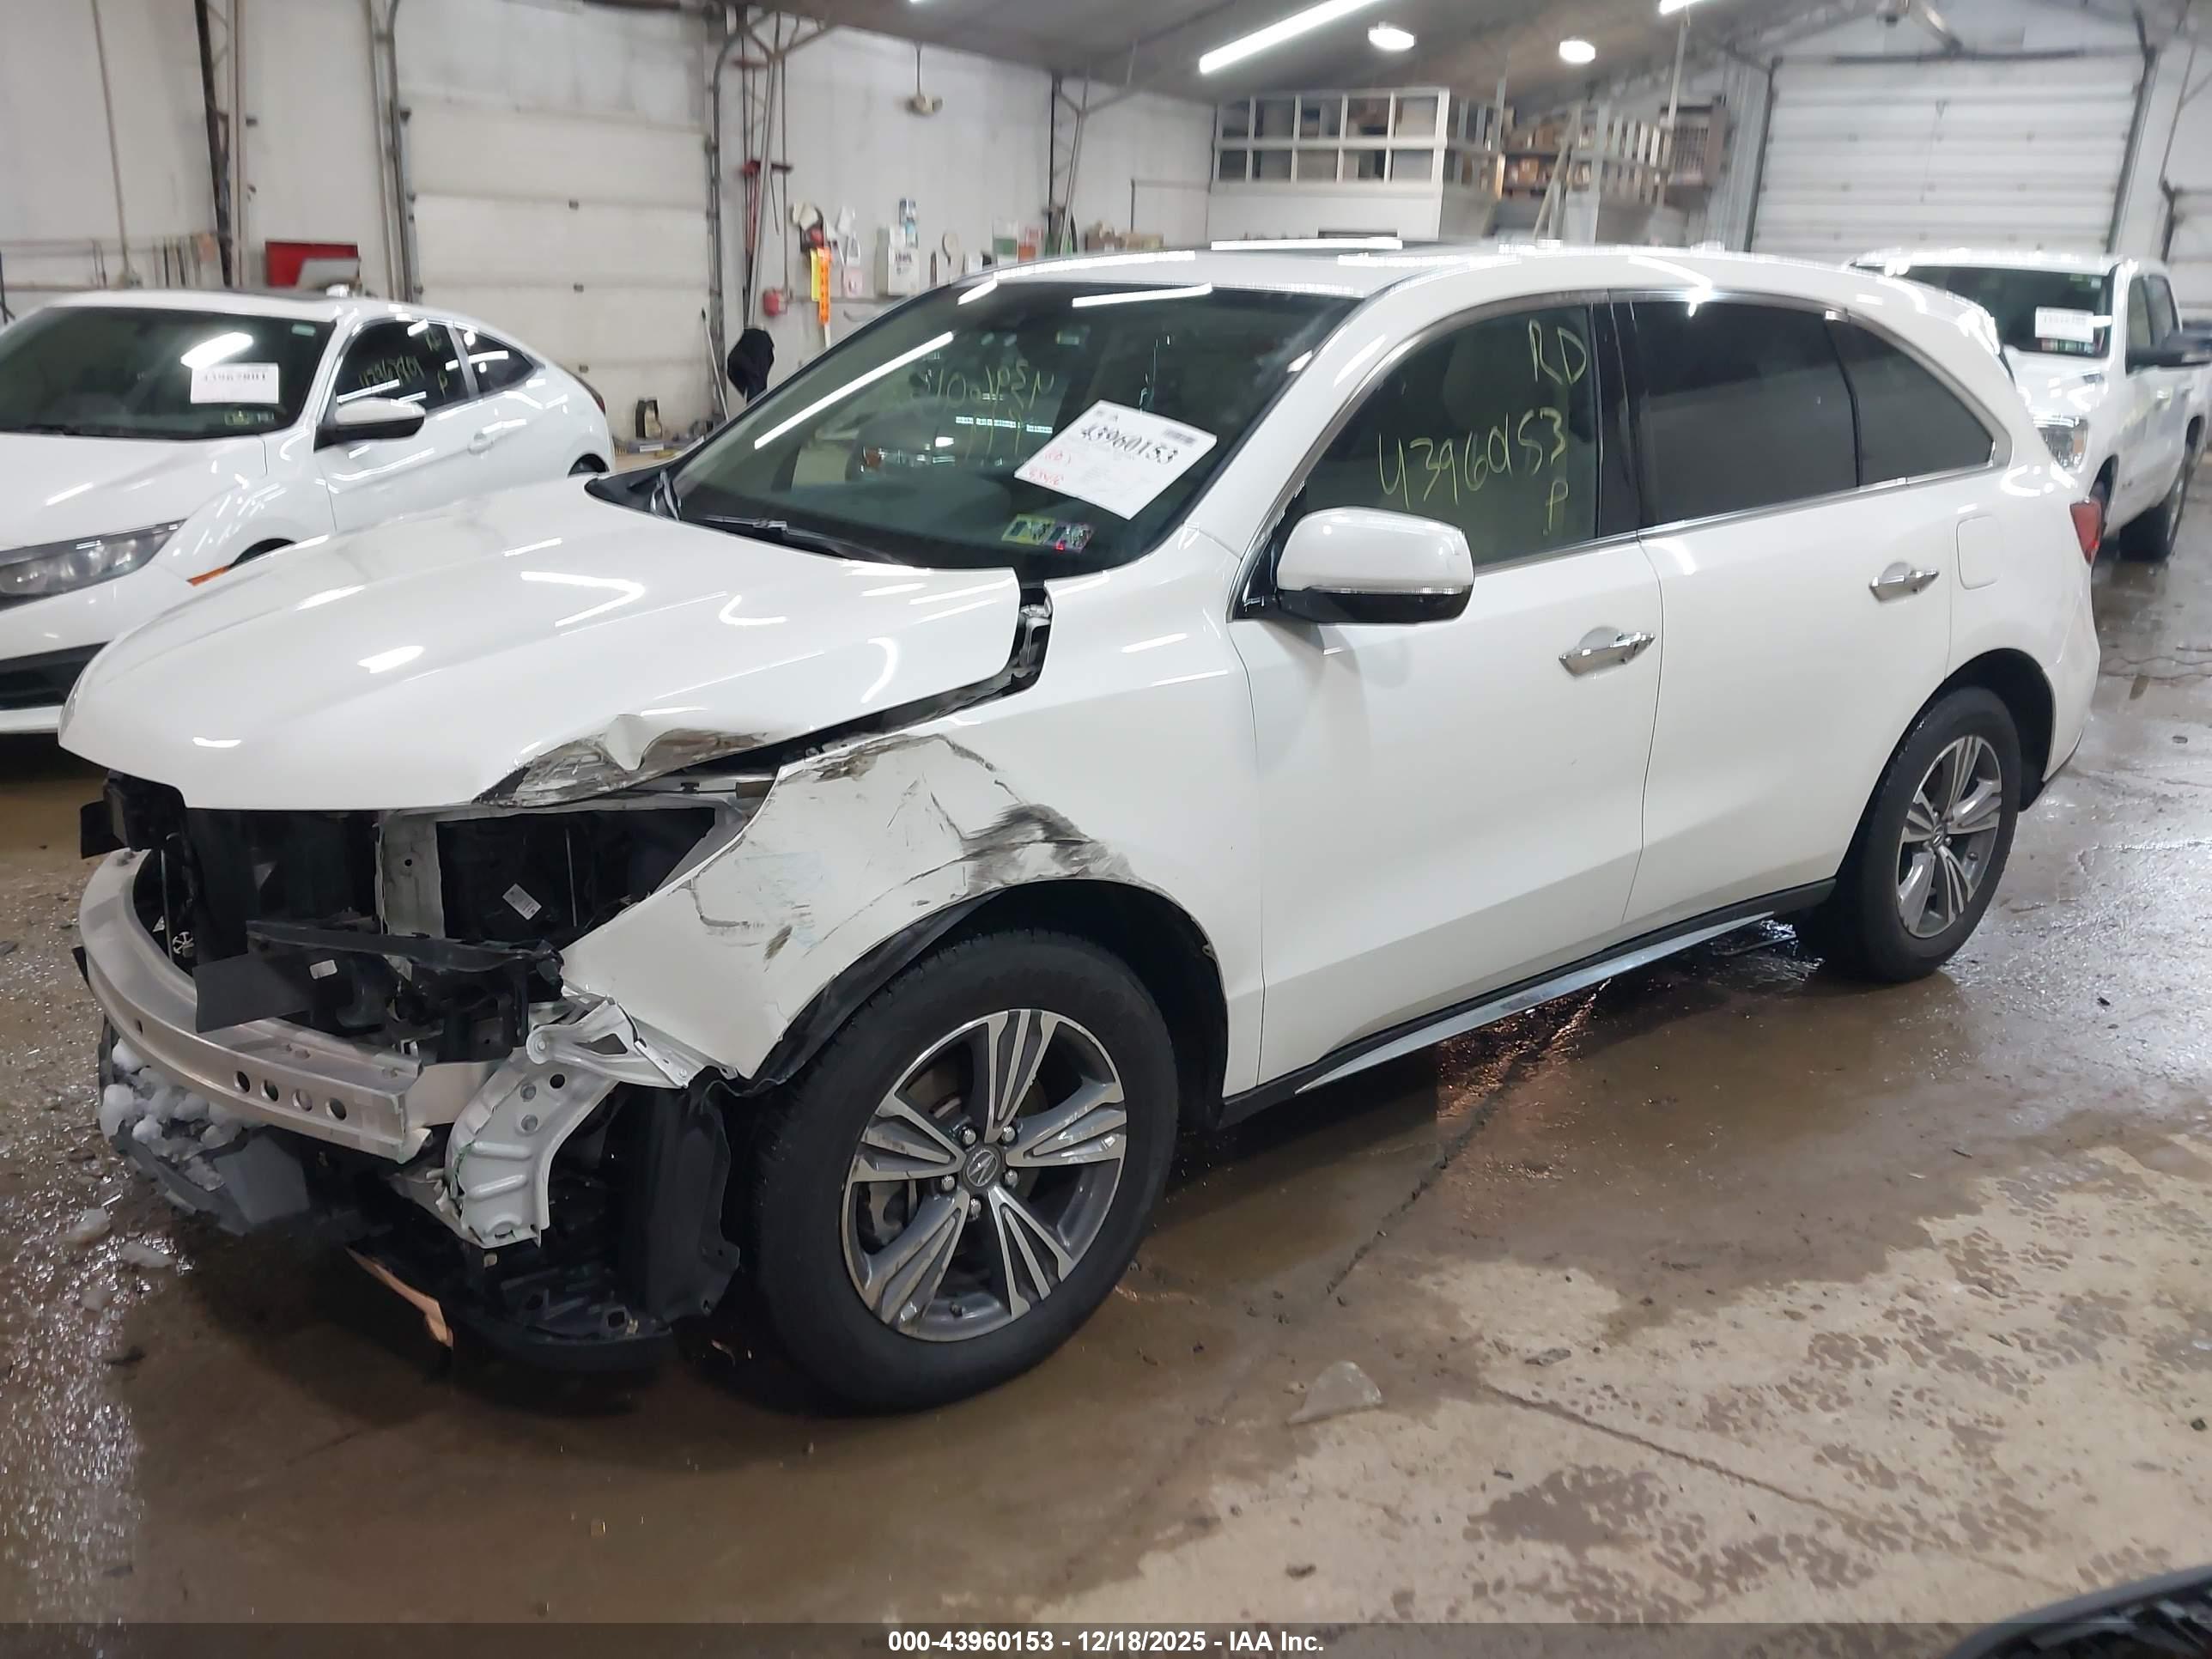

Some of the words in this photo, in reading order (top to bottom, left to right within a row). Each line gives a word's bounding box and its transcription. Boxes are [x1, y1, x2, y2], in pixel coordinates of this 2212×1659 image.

[1528, 318, 1588, 385] RD
[1080, 424, 1179, 465] 43960153
[1378, 407, 1567, 511] 43960153
